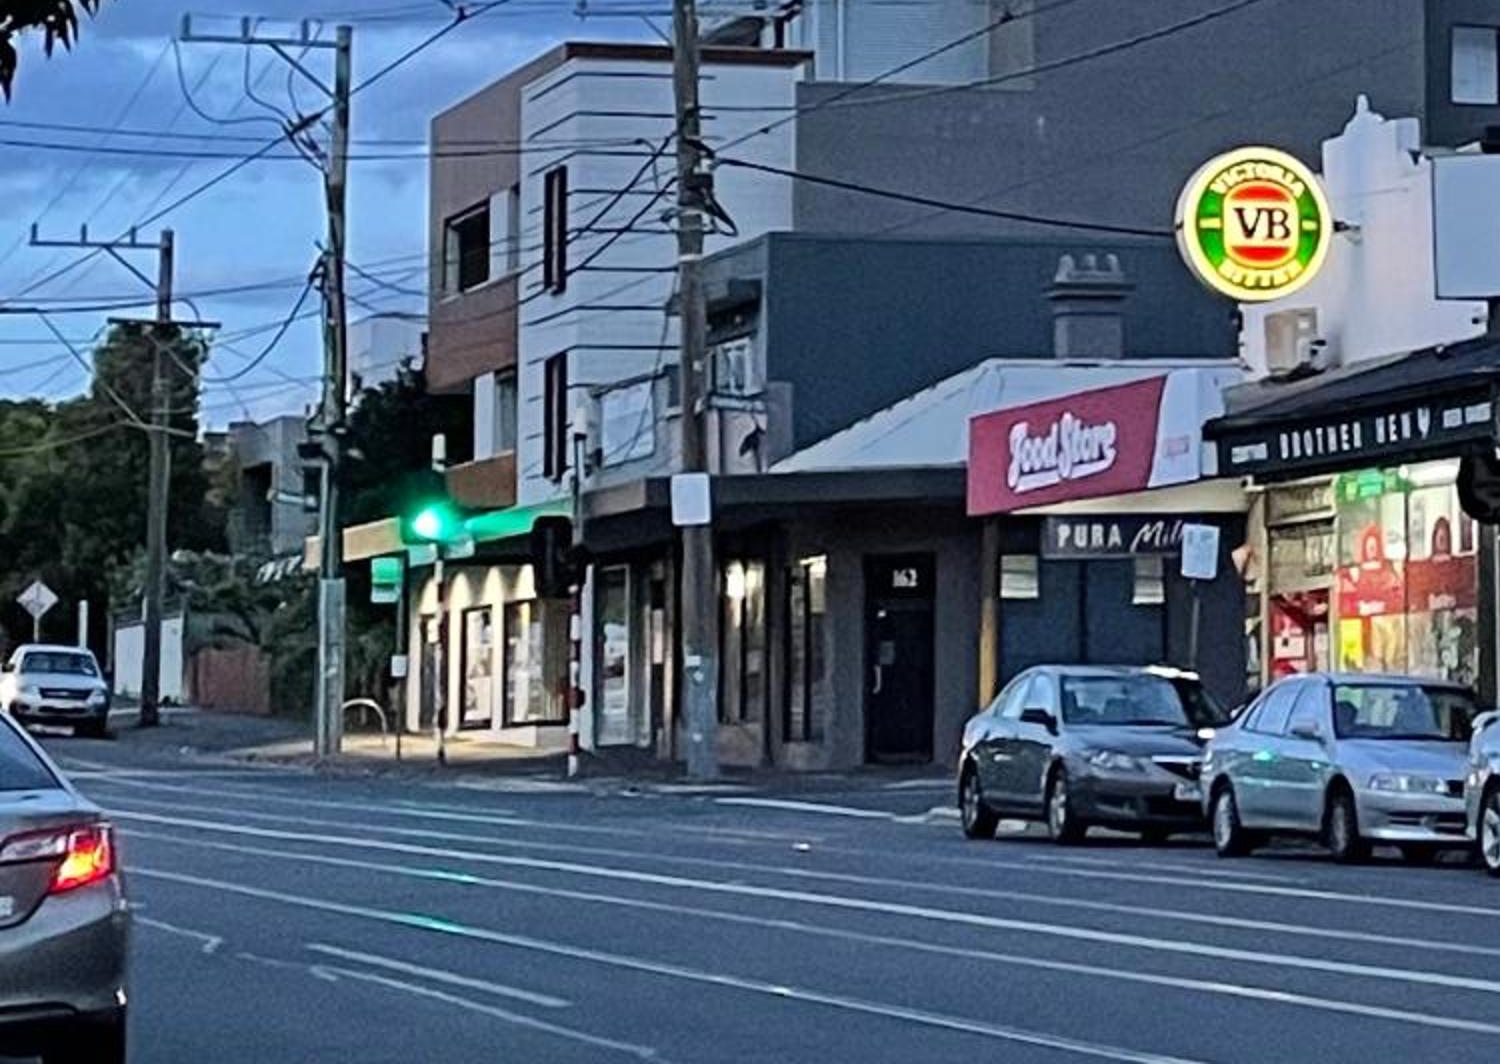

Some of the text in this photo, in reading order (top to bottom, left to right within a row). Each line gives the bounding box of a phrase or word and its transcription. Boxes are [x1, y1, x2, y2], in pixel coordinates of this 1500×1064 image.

[1233, 207, 1291, 240] VB
[1007, 410, 1118, 488] Food Store
[1279, 421, 1363, 460] BROTHER
[1056, 523, 1123, 549] PURA
